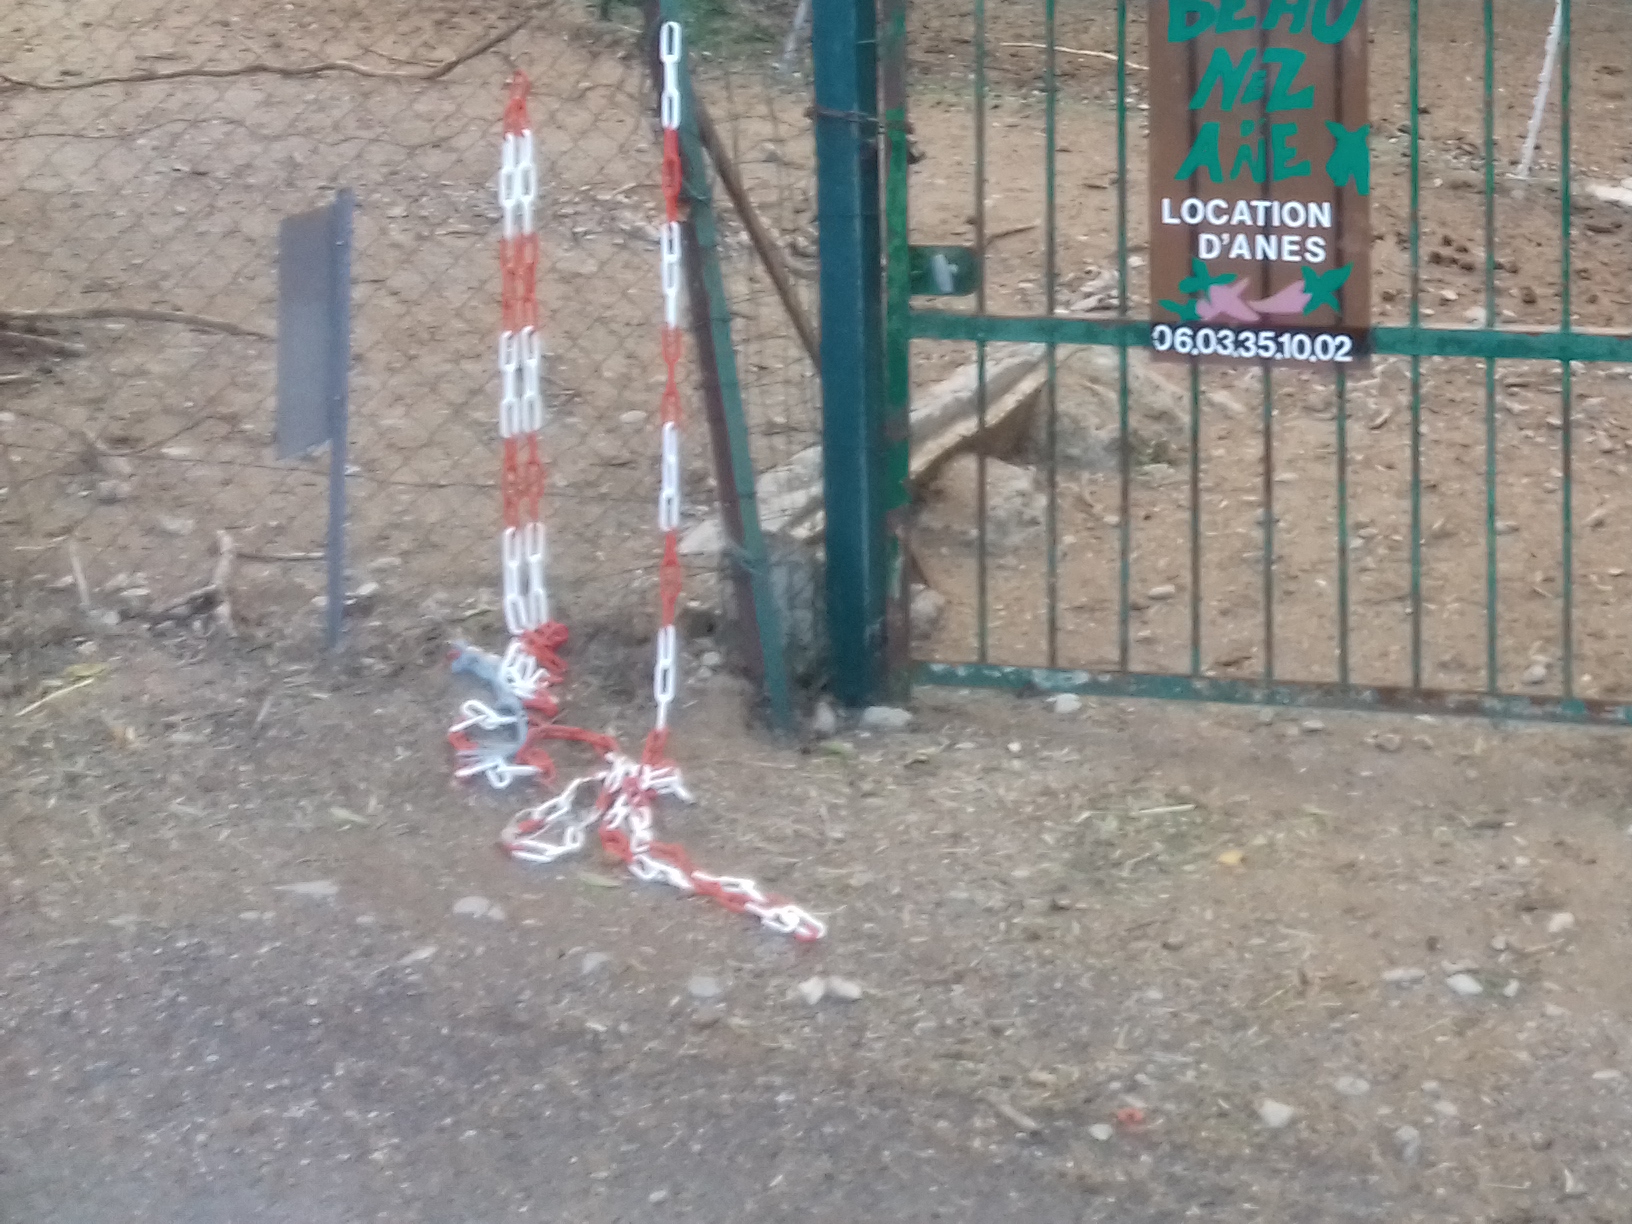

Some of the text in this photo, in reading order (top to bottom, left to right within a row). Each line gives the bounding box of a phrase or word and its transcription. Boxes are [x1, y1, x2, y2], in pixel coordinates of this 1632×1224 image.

[1160, 197, 1333, 228] LOCATION
[1197, 232, 1327, 263] D'ANES
[1151, 324, 1354, 362] 06.03.35.10.02
